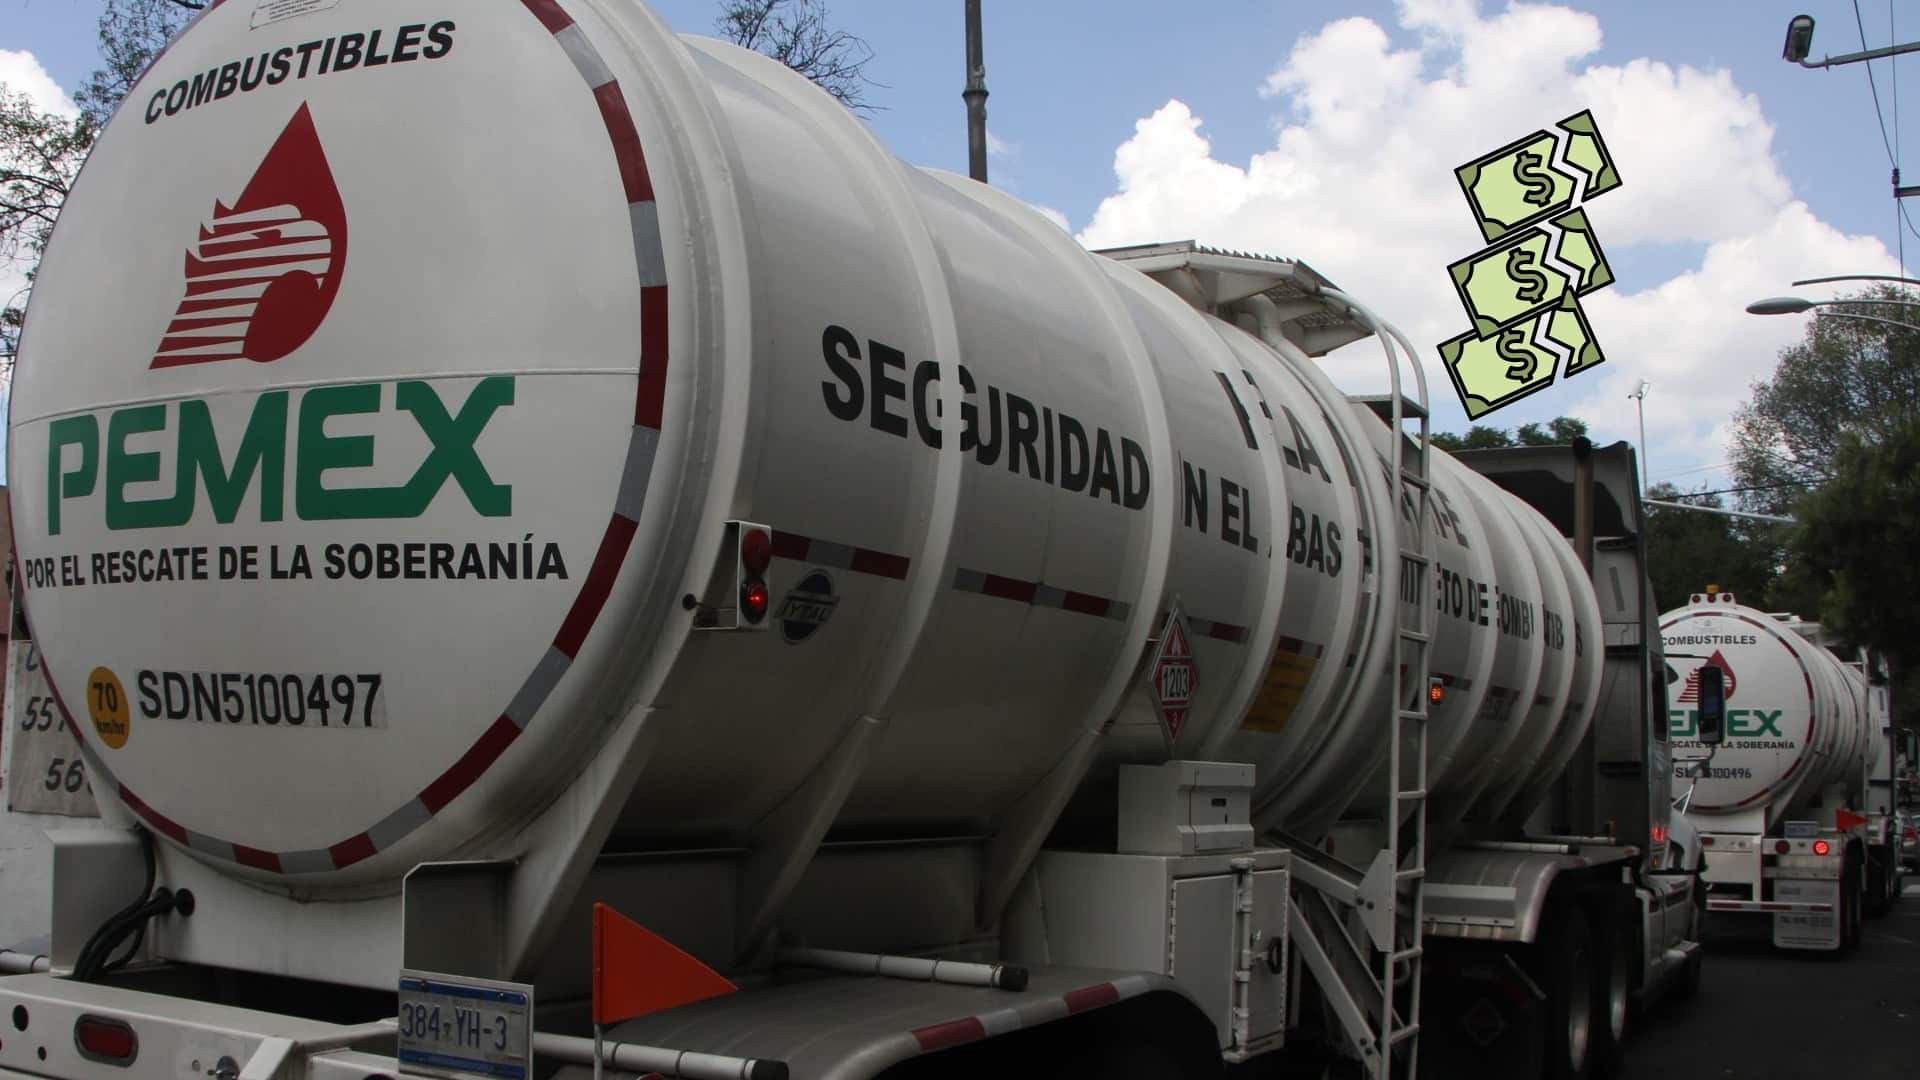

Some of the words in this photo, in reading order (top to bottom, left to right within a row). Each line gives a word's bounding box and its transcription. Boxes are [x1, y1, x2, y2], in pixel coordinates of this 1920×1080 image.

[144, 20, 457, 125] COMBUSTIBLES
[821, 324, 1151, 511] SEGURIDAD
[48, 376, 515, 535] PEMEX
[1221, 477, 1259, 554] EL
[25, 556, 56, 589] POR
[61, 555, 86, 587] EL
[92, 546, 208, 584] RESCATE
[219, 545, 259, 581] DE
[270, 543, 313, 580] LA
[323, 533, 569, 580] SOBERANÍA
[93, 682, 118, 713] 70
[137, 670, 382, 728] SDN5100497
[1164, 667, 1189, 698] 1203
[22, 697, 65, 732] 55
